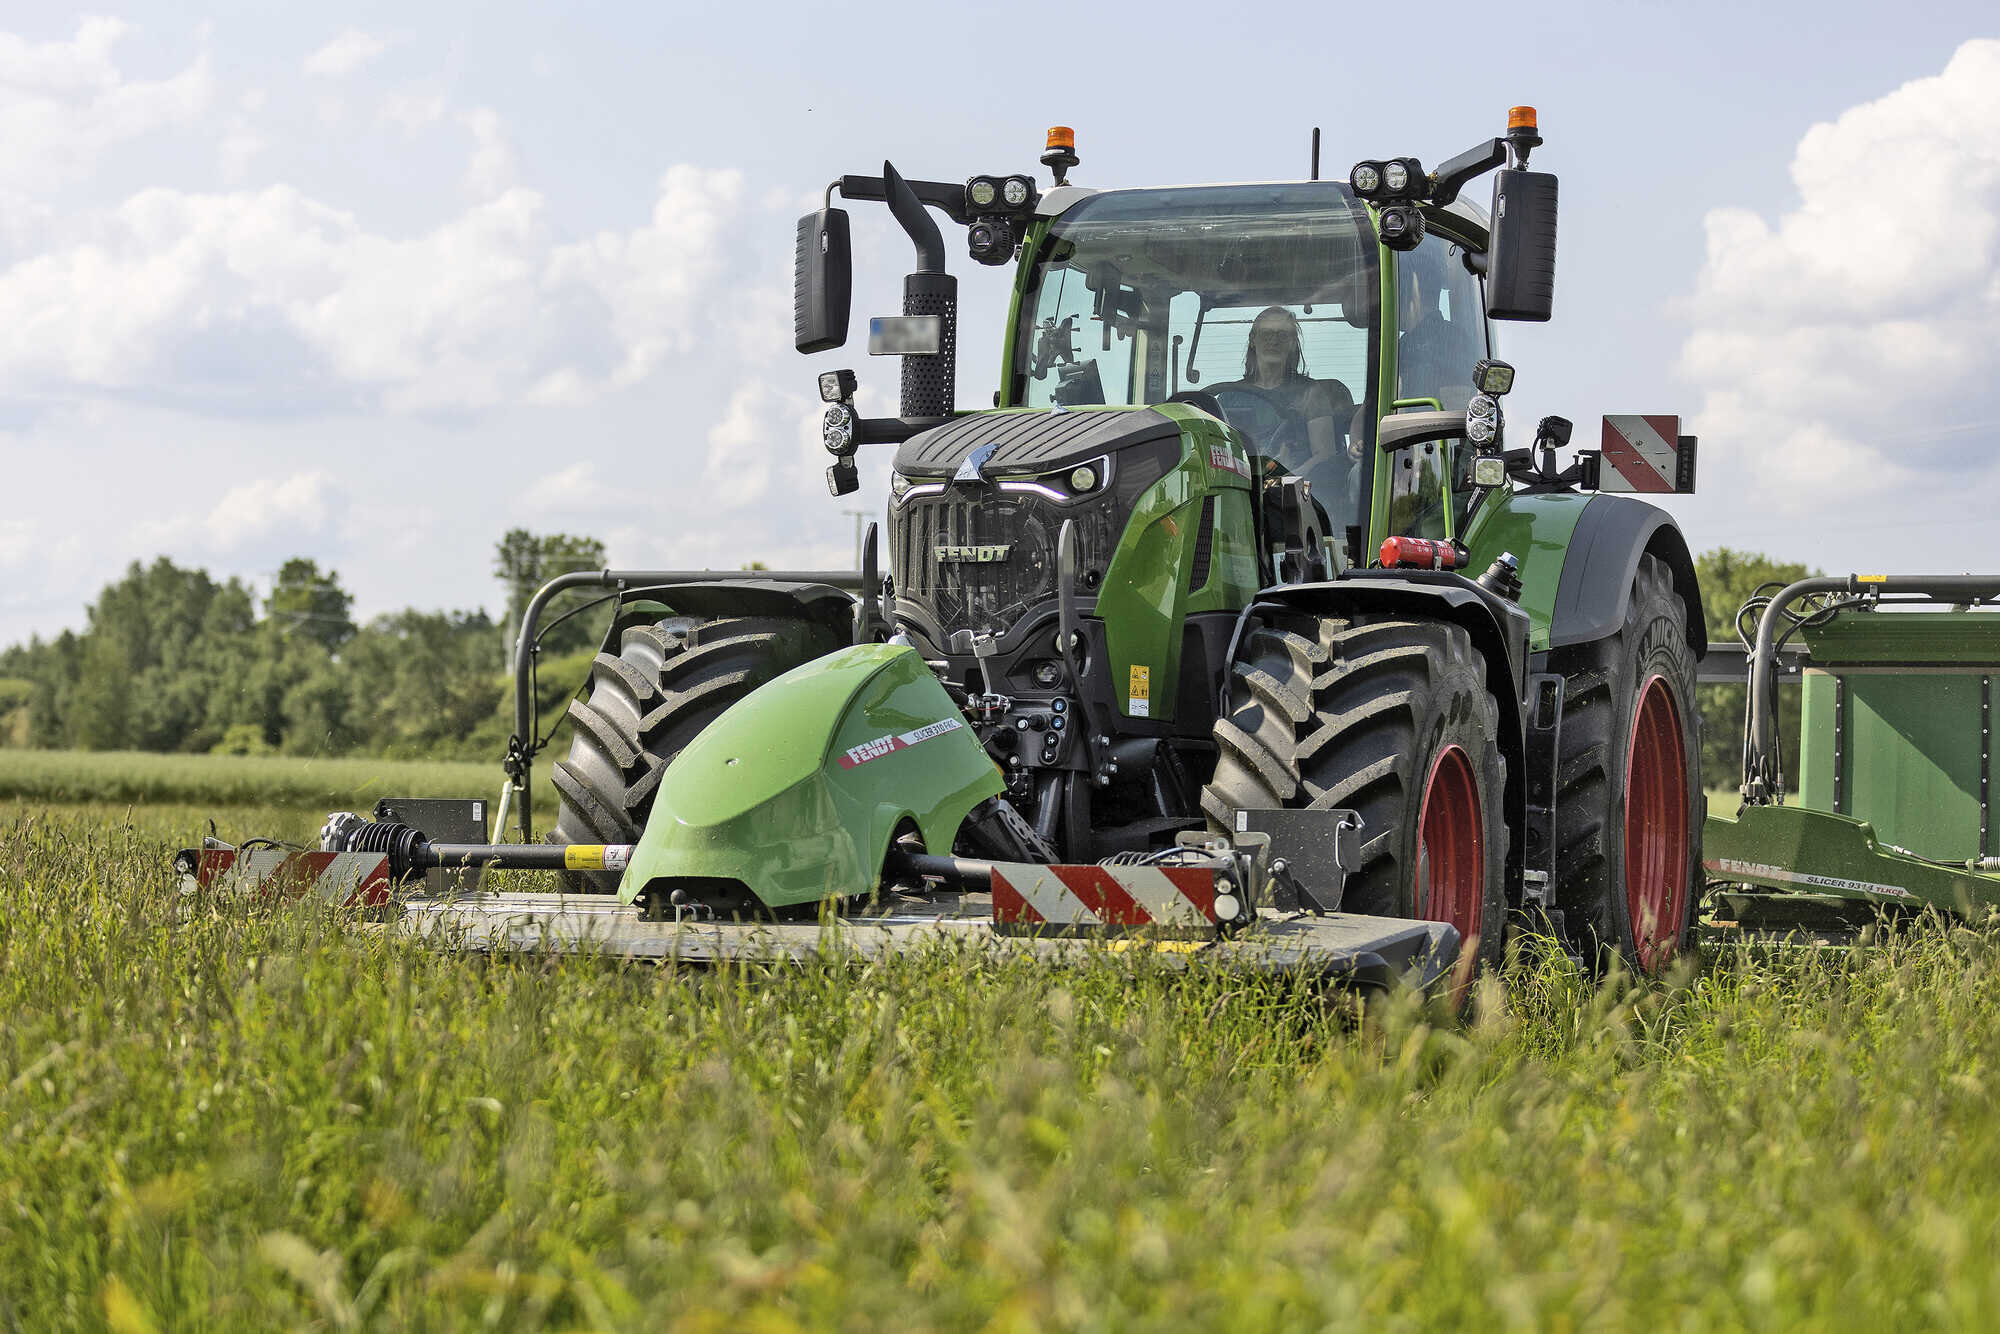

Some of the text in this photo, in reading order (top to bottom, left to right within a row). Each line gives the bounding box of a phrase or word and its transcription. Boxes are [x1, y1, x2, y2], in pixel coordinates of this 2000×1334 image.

[1210, 445, 1234, 468] FEN
[934, 545, 1011, 562] FENDT
[913, 726, 934, 741] SLICER
[846, 735, 896, 764] FENDT
[1807, 876, 1846, 888] SLICER
